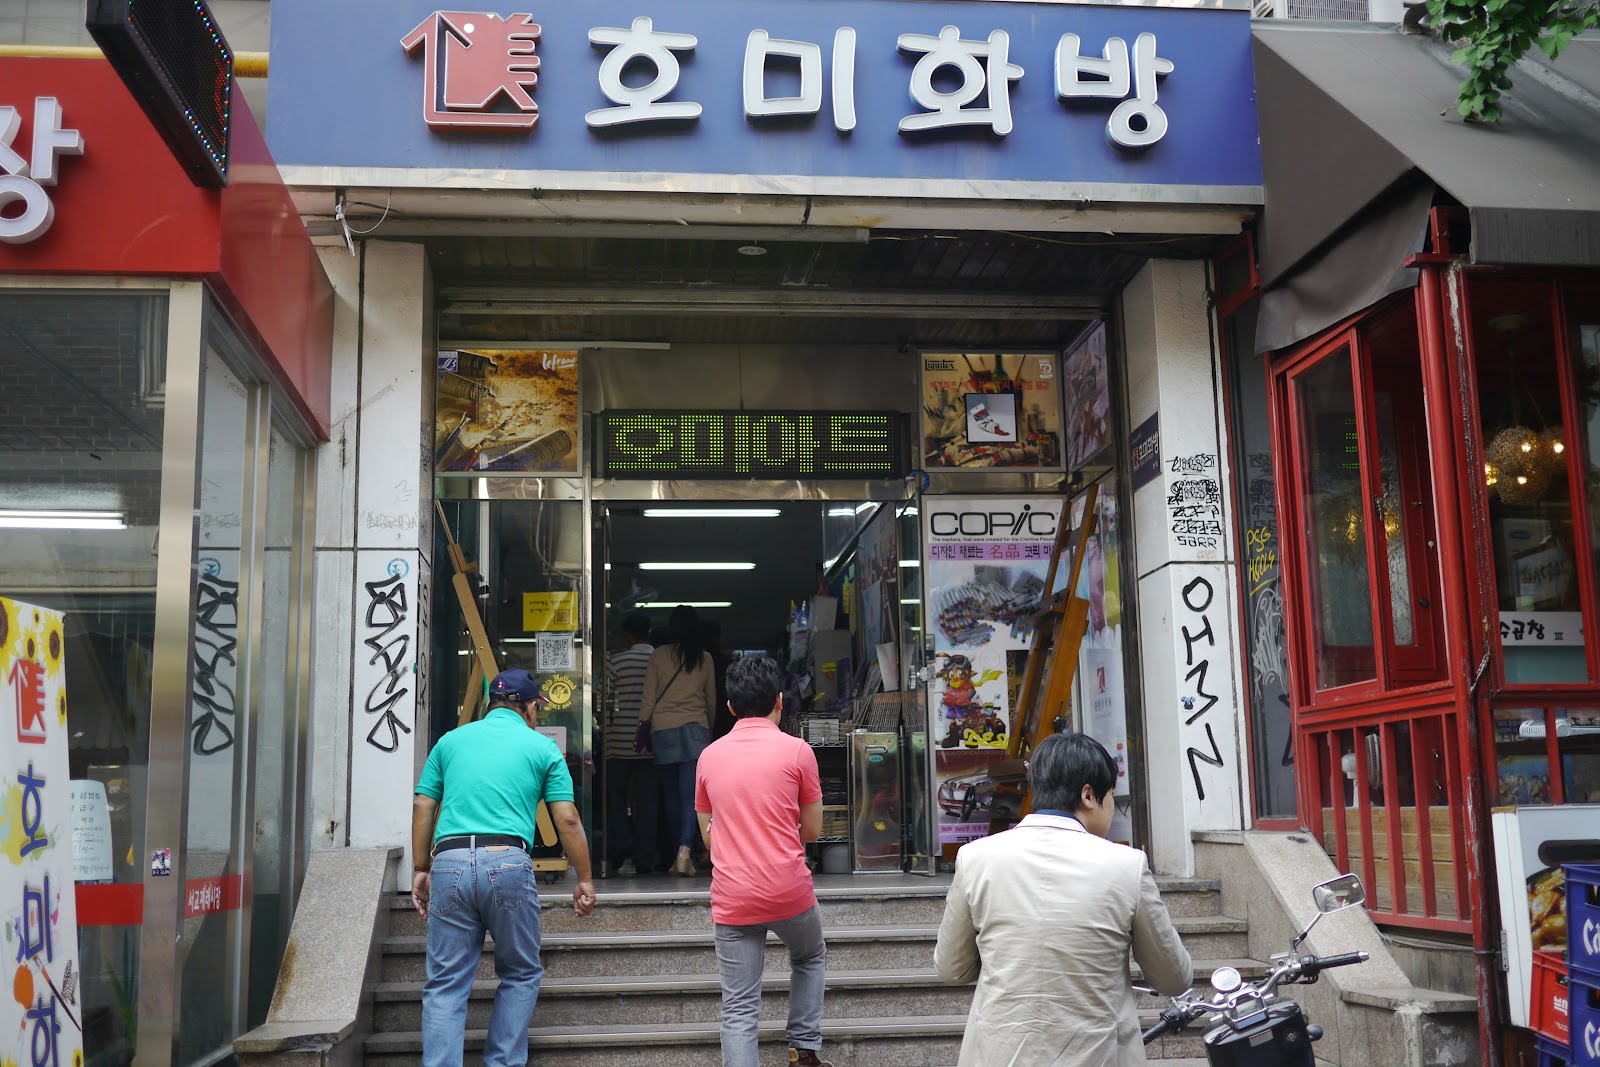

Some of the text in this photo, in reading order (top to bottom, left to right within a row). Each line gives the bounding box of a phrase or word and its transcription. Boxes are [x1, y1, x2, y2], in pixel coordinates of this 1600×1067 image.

[585, 16, 1175, 148] 호미화방
[924, 358, 955, 371] Liquitex
[607, 413, 889, 473] 호미아트
[931, 545, 956, 559] 디자인
[959, 545, 984, 559] 재료는
[989, 544, 1020, 559] 名品
[1024, 545, 1041, 559] 코픽
